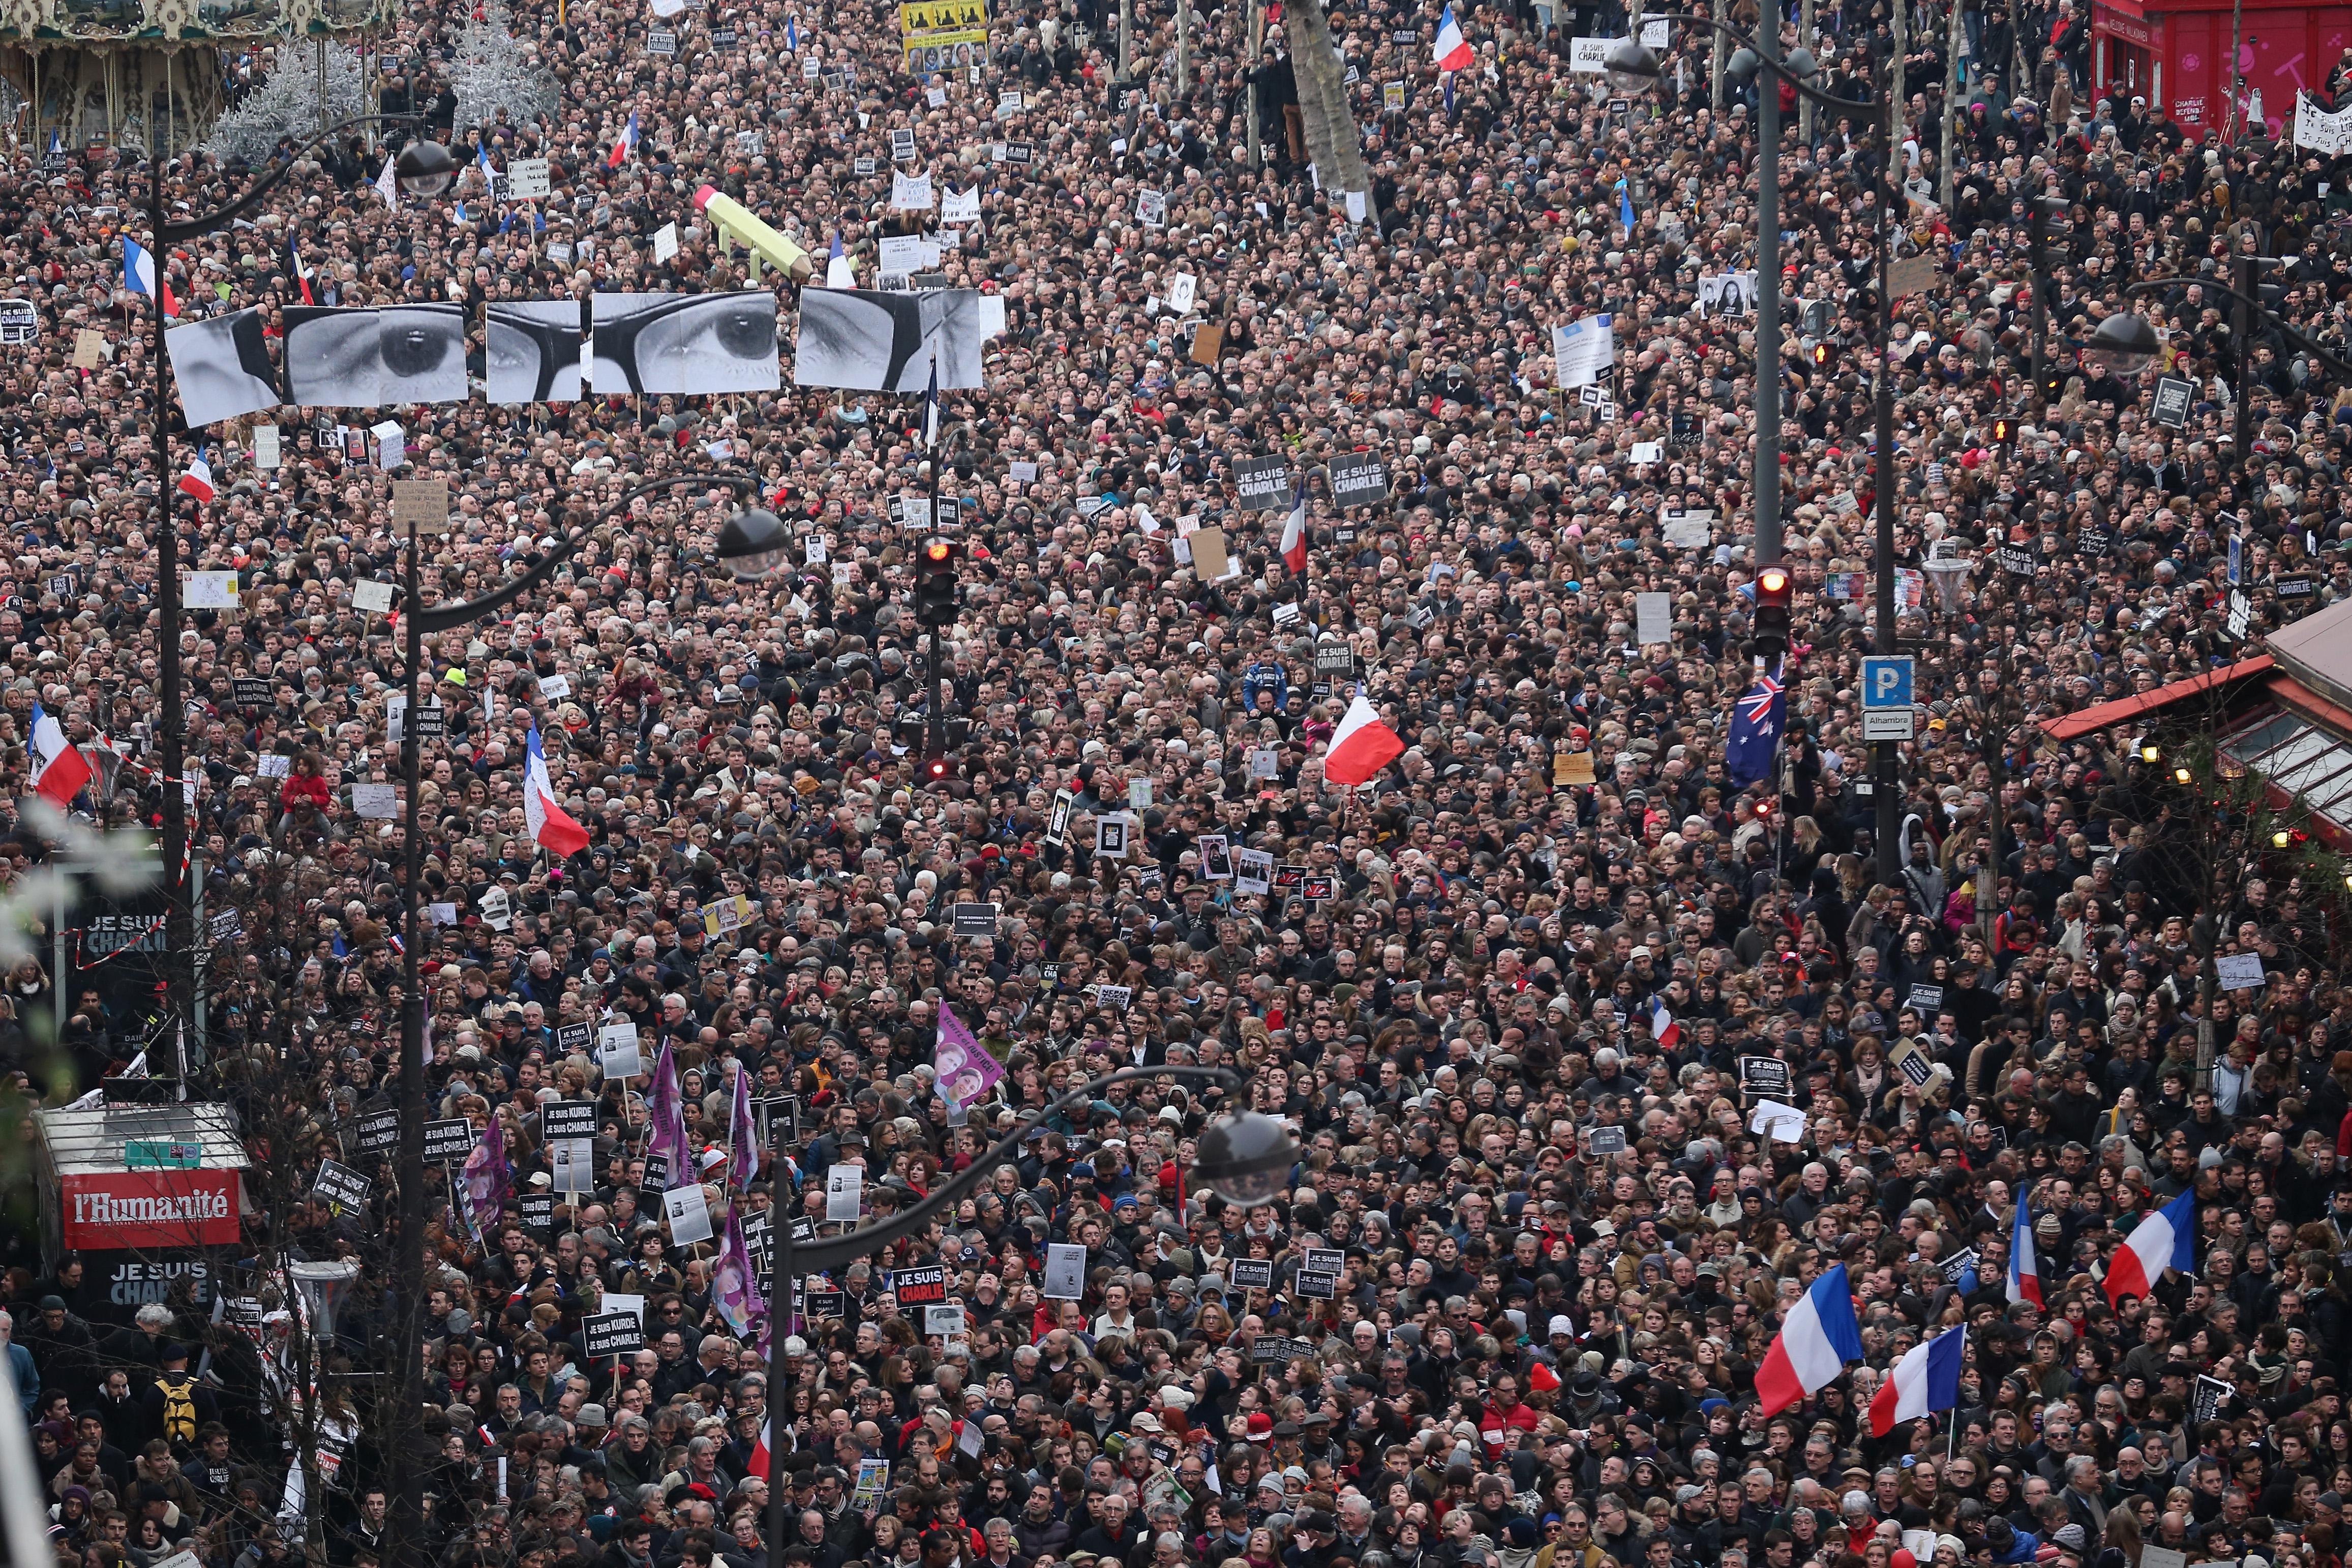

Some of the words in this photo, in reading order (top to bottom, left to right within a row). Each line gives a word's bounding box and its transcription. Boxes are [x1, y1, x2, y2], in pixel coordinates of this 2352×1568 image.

[1642, 28, 1667, 40] AFRAID
[650, 41, 673, 50] CHARLIE
[1590, 43, 1604, 51] SUIS
[1, 315, 34, 324] CHARLIE
[1238, 472, 1253, 484] JE
[1254, 466, 1284, 480] SUIS
[1334, 470, 1348, 480] JE
[1350, 463, 1382, 476] SUIS
[1238, 477, 1288, 497] CHARLIE
[1334, 474, 1384, 494] CHARLIE
[1178, 518, 1198, 530] WHY
[2278, 584, 2311, 595] CHARLIE
[1318, 648, 1328, 657] JE
[1328, 646, 1349, 656] SUIS
[1317, 656, 1350, 669] CHARLIE
[1877, 667, 1899, 699] P
[1869, 715, 1908, 725] Alhambra
[419, 722, 442, 732] CHARLIE
[1142, 869, 1160, 877] SUIS
[87, 916, 116, 932] JE
[1922, 989, 1941, 998] SUIS
[1911, 995, 1940, 1006] CHARLIE
[571, 1028, 585, 1037] SUIS
[562, 1034, 589, 1046] CHARLIE
[968, 1043, 996, 1074] JUSTICE!
[1750, 1061, 1761, 1069] JE
[1761, 1061, 1784, 1071] SUIS
[1750, 1069, 1785, 1080] CHARLIE
[548, 1113, 555, 1122] JE
[555, 1112, 568, 1121] SUIS
[569, 1109, 592, 1121] KURDE
[425, 1130, 432, 1139] JE
[432, 1129, 443, 1139] SUIS
[443, 1125, 465, 1137] KURDE
[546, 1128, 553, 1136] JE
[553, 1127, 566, 1136] SUIS
[566, 1124, 595, 1136] CHARLIE
[425, 1146, 431, 1155] JE
[431, 1144, 443, 1154] SUIS
[443, 1139, 470, 1153] CHARLIE
[650, 1162, 657, 1171] JE
[657, 1163, 666, 1173] SUI
[73, 1187, 228, 1223] l'Humanité
[535, 1200, 551, 1211] KURDE
[766, 1235, 774, 1245] JE
[767, 1251, 774, 1261] JE
[1309, 1262, 1341, 1272] CHARLIE
[1944, 1264, 1954, 1275] JE
[1954, 1254, 1973, 1269] SUIS
[110, 1264, 143, 1282] JE
[148, 1262, 207, 1280] SUIS
[1236, 1272, 1268, 1282] CHARLIE
[897, 1274, 914, 1286] JE
[915, 1271, 942, 1283] SUIS
[1312, 1276, 1332, 1285] SUIS
[762, 1282, 769, 1290] JE
[1301, 1282, 1332, 1293] CHARLIE
[899, 1283, 944, 1302] CHARLIE
[589, 1325, 597, 1335] JE
[596, 1322, 611, 1333] SUIS
[610, 1318, 636, 1332] KURDE
[588, 1341, 596, 1350] JE
[596, 1339, 610, 1349] SUIS
[610, 1333, 641, 1347] CHARLIE
[1254, 1348, 1275, 1358] CHARLIE
[1281, 1341, 1291, 1350] JE
[1292, 1345, 1313, 1355] SUIS
